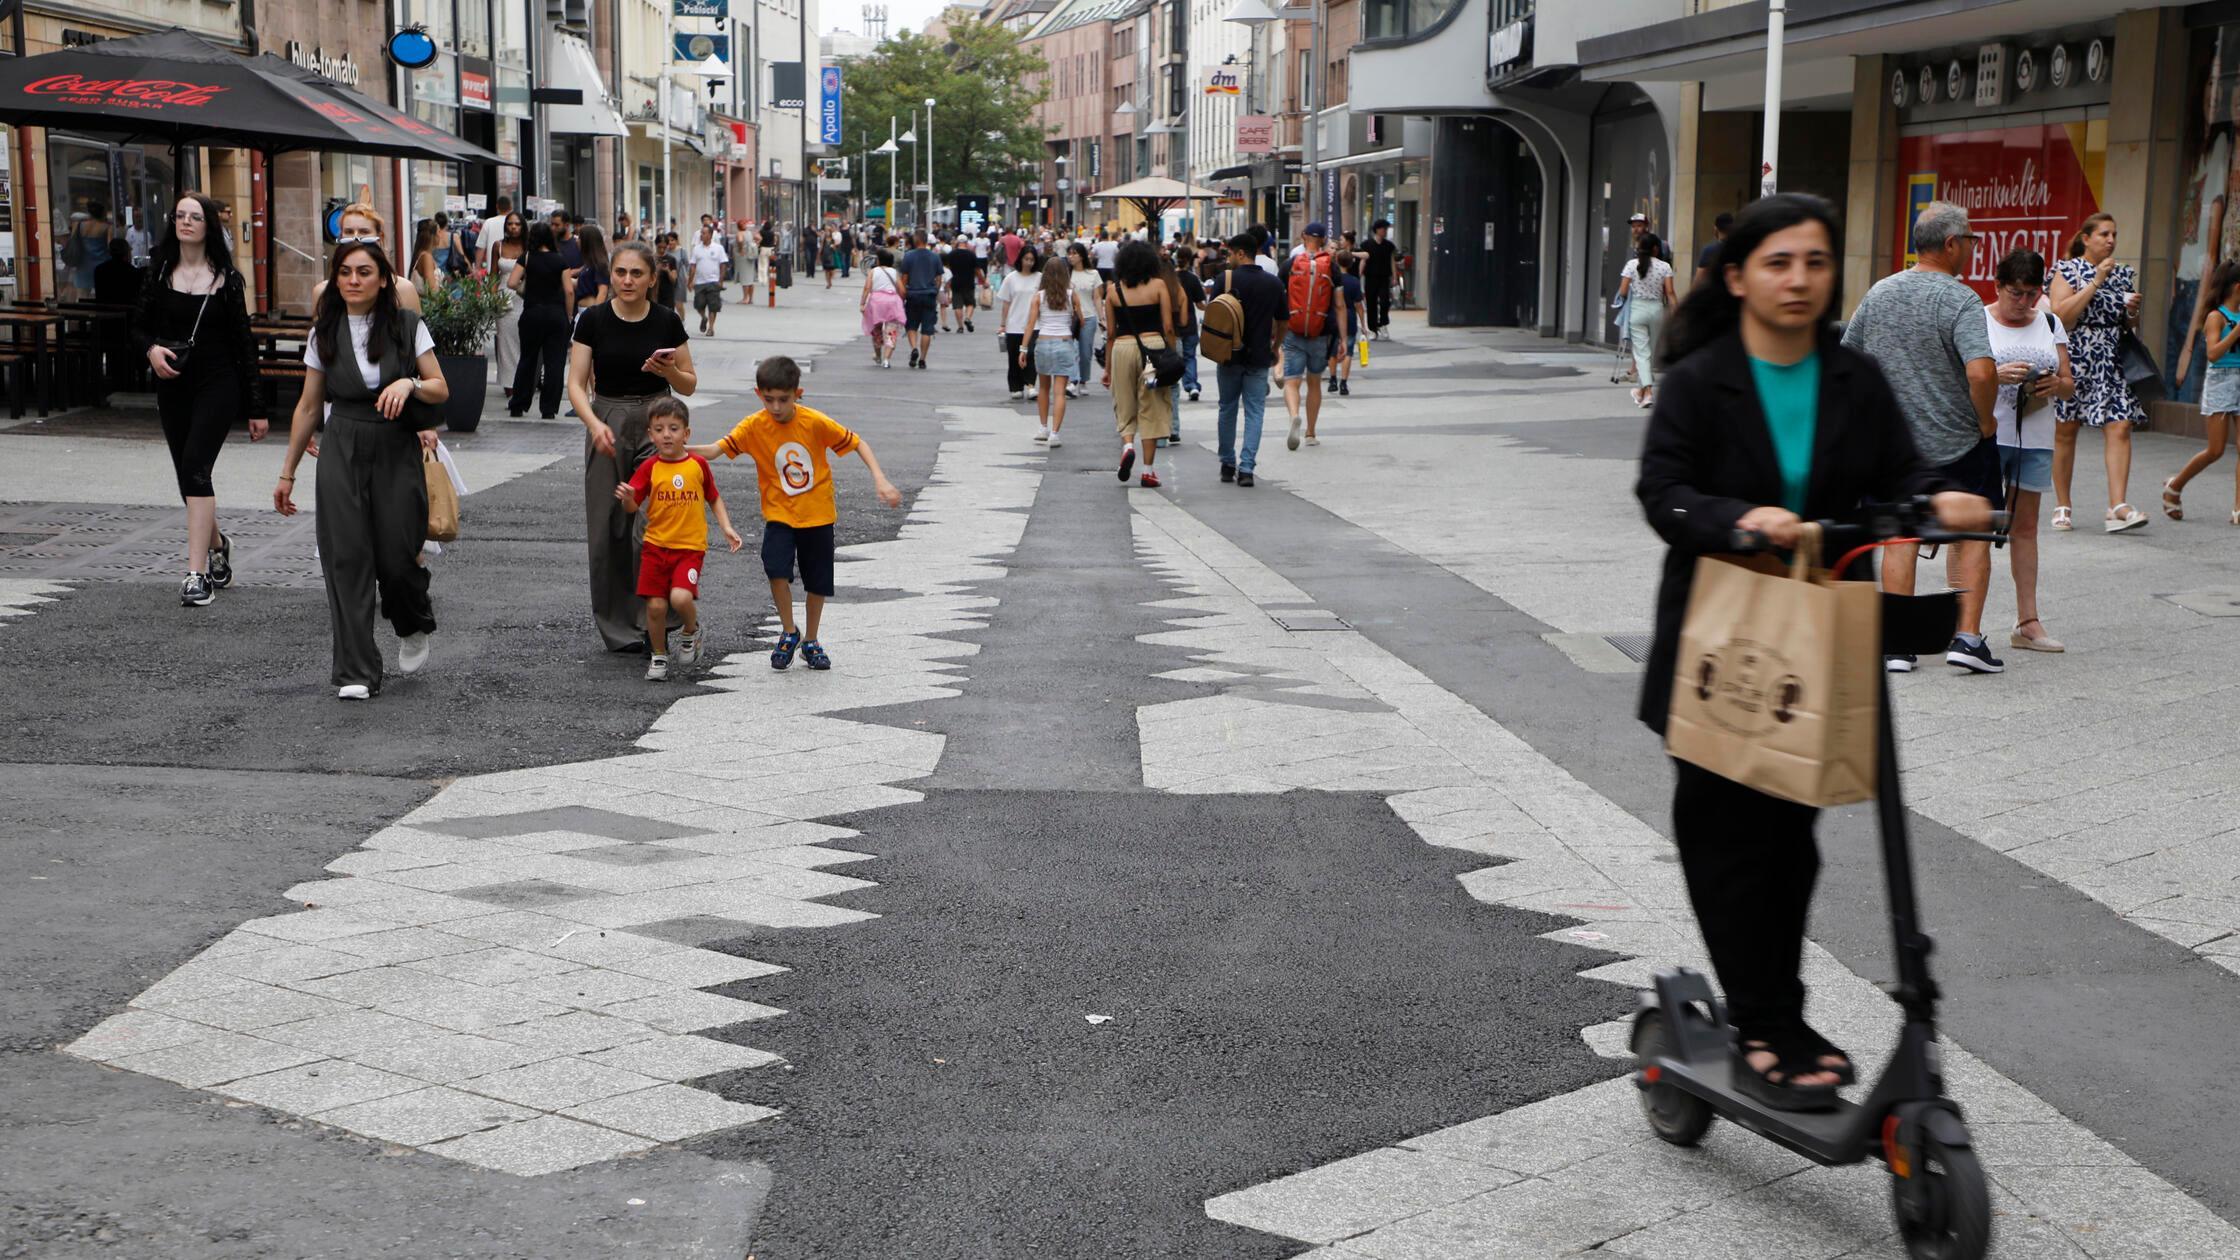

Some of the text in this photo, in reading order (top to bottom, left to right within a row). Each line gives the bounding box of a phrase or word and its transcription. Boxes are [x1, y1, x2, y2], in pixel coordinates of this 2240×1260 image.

[291, 41, 359, 86] blue-tomato
[1211, 70, 1237, 86] dm
[24, 74, 231, 106] Coca-Cola
[57, 96, 163, 109] ZERO SUGAR
[779, 99, 804, 108] ecco
[823, 99, 838, 143] Apollo
[1238, 137, 1270, 145] BEER
[1222, 186, 1243, 198] dm
[1942, 157, 2051, 216] Kulinarikwelten
[657, 490, 699, 501] GALATA
